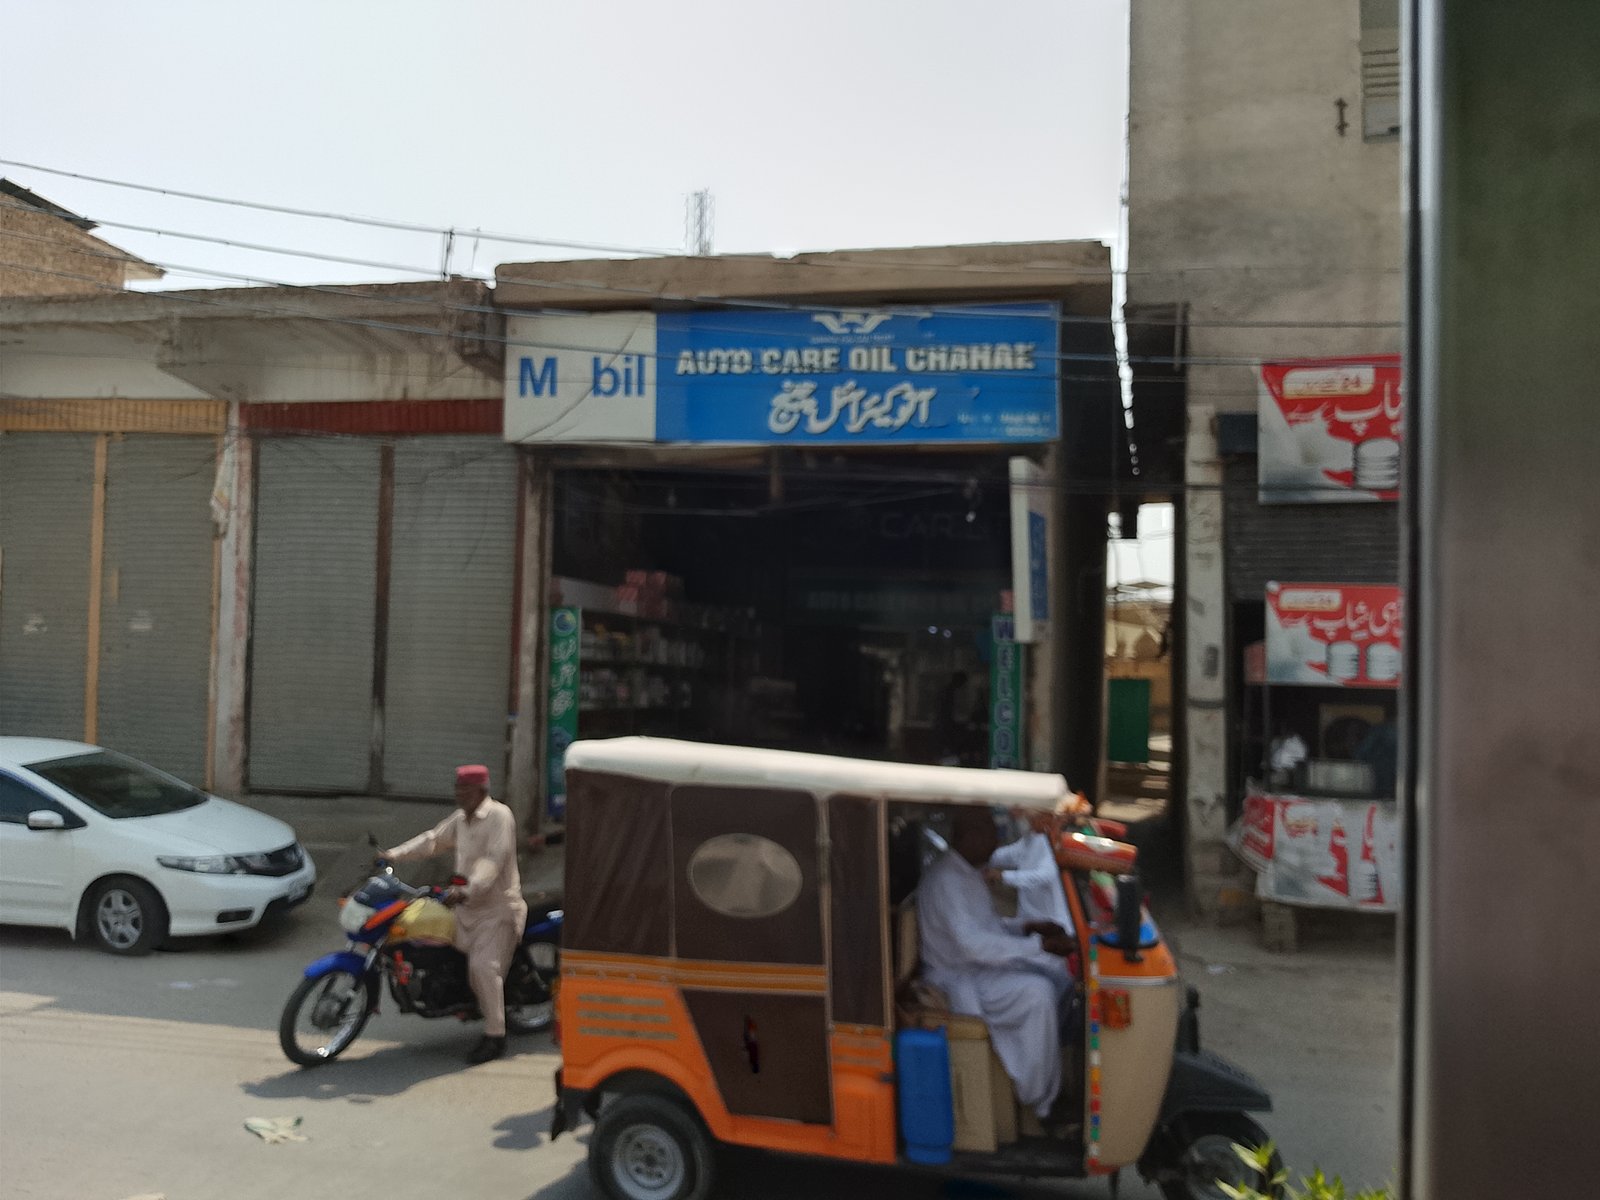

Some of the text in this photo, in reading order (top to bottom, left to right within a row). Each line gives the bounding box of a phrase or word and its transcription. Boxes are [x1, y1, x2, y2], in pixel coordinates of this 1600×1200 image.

[676, 349, 753, 375] AUTO
[761, 346, 841, 374] CARE
[851, 345, 897, 372] OIL
